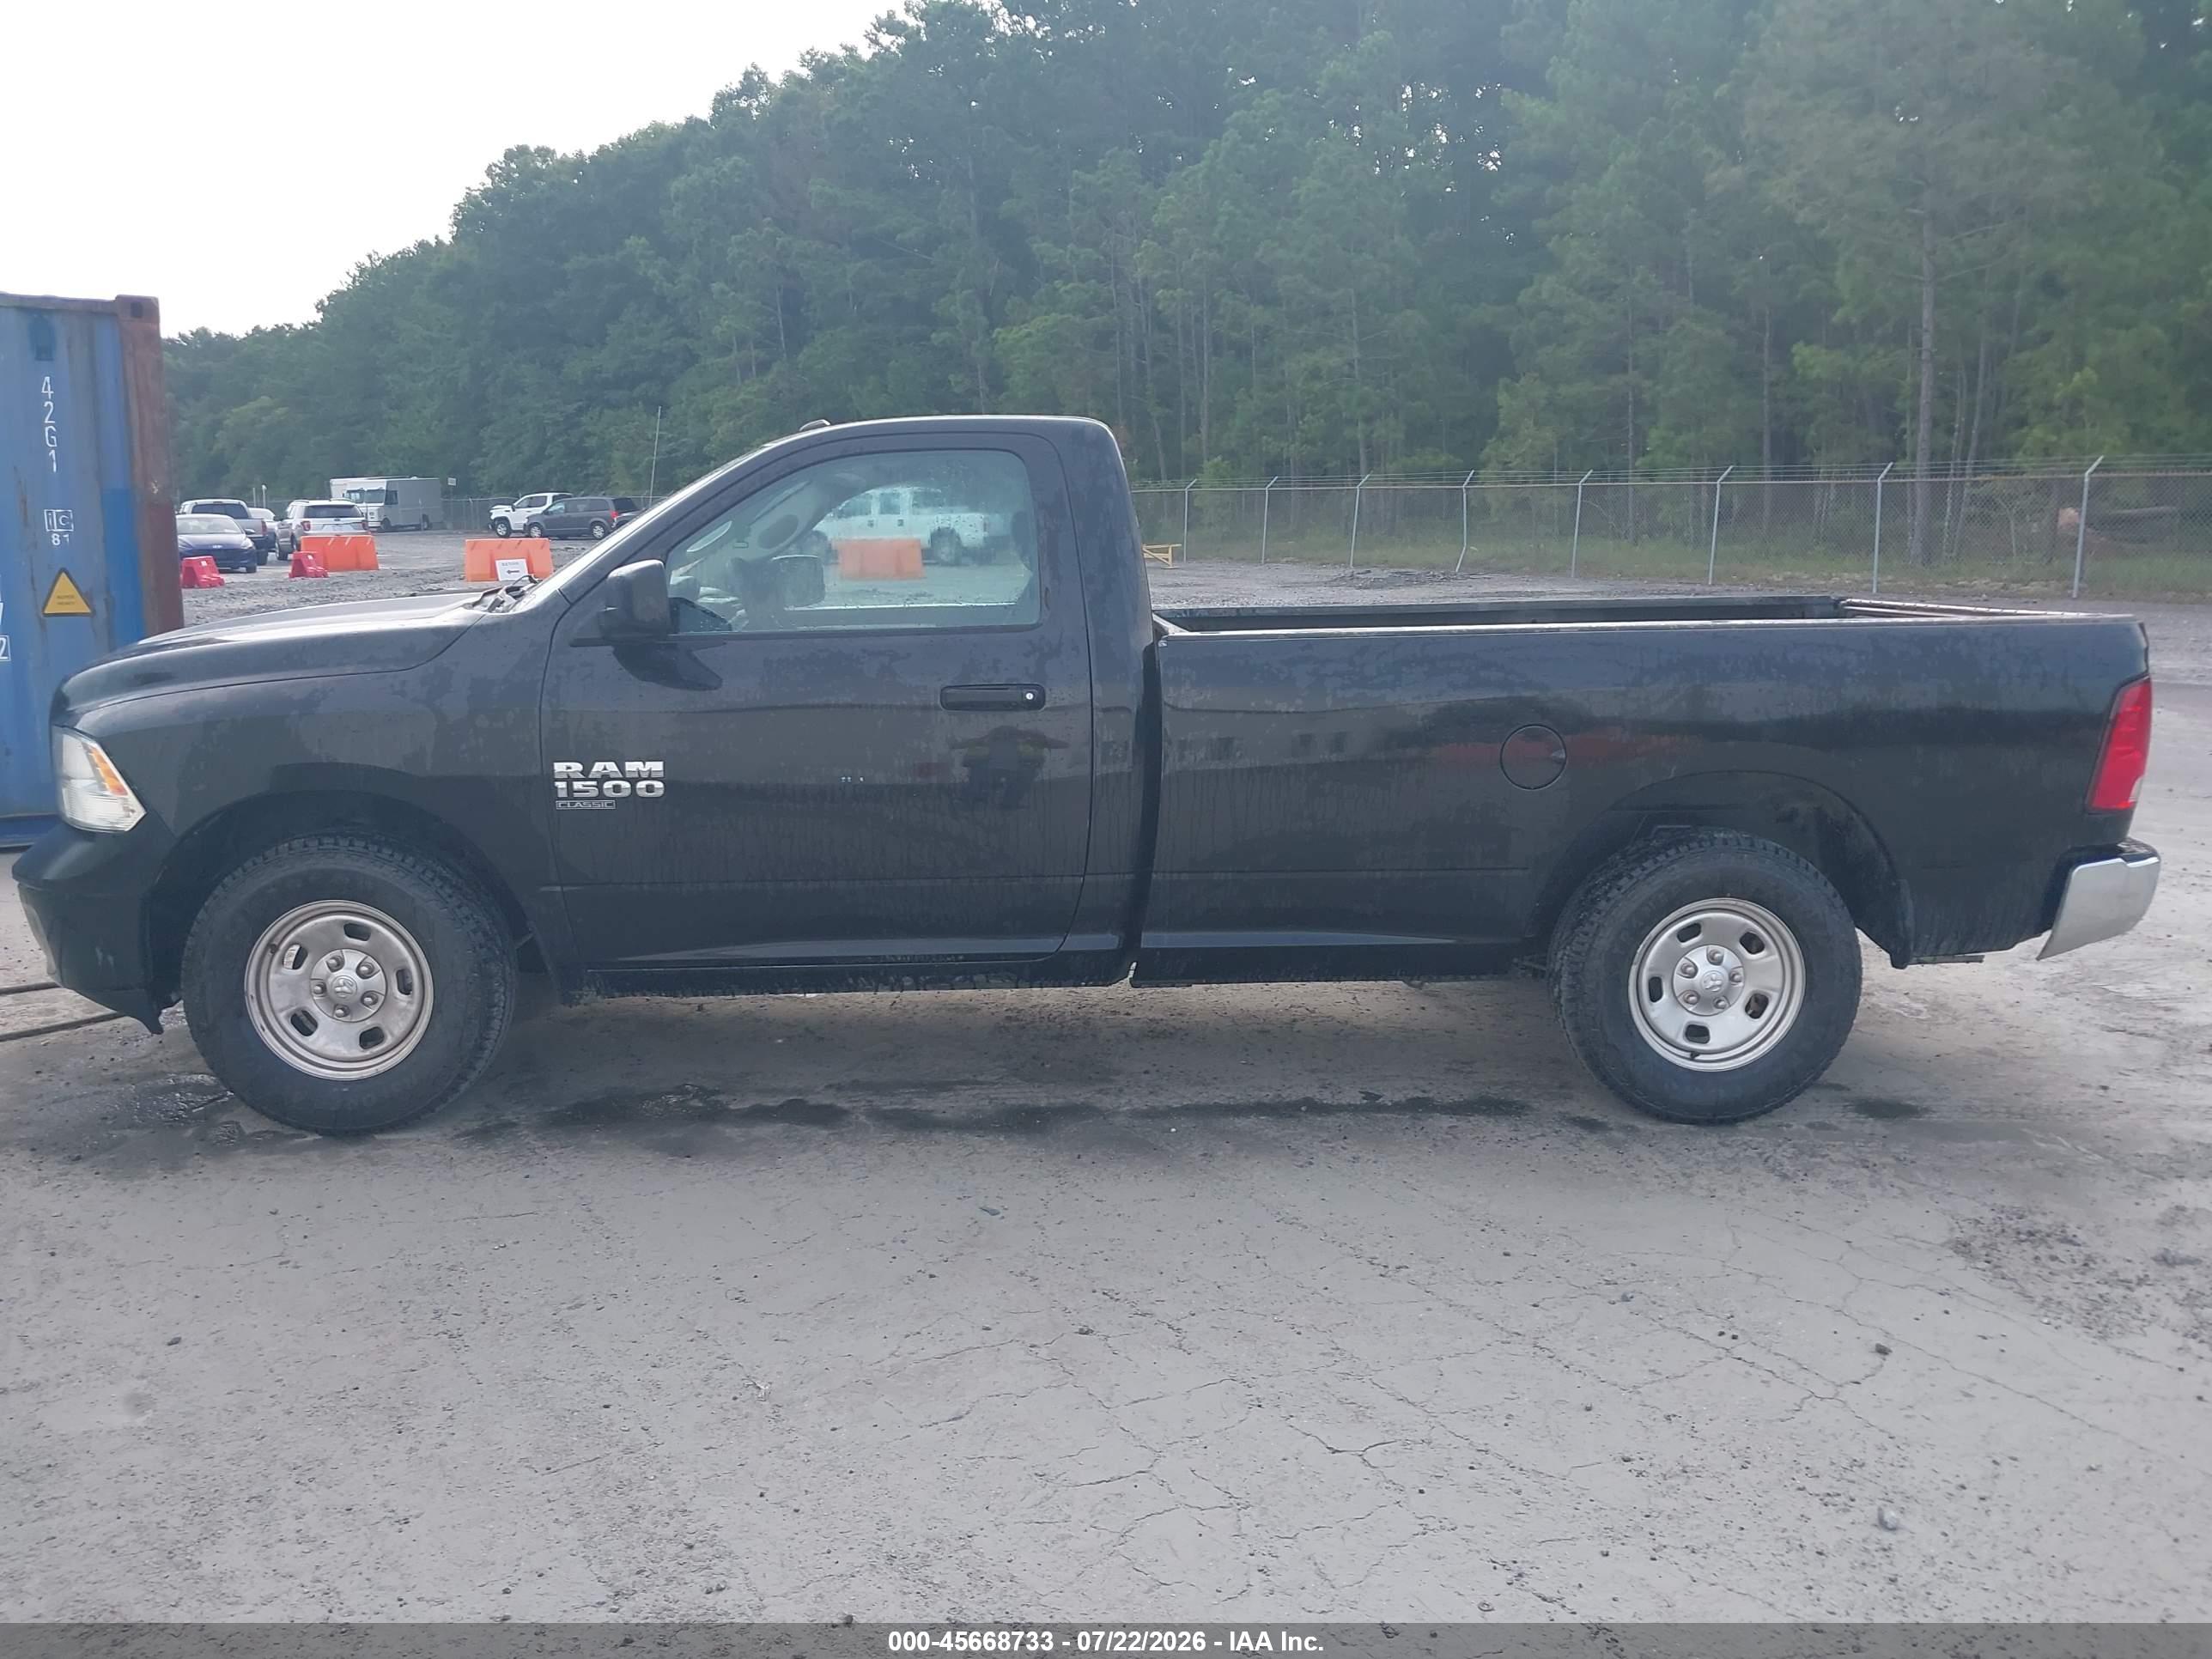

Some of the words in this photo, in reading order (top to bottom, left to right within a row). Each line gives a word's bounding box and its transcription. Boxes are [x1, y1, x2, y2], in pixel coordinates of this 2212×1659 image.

[41, 376, 58, 473] 42G1
[553, 761, 665, 779] RAM
[554, 780, 665, 798] 1500
[557, 800, 614, 809] CLASSIC
